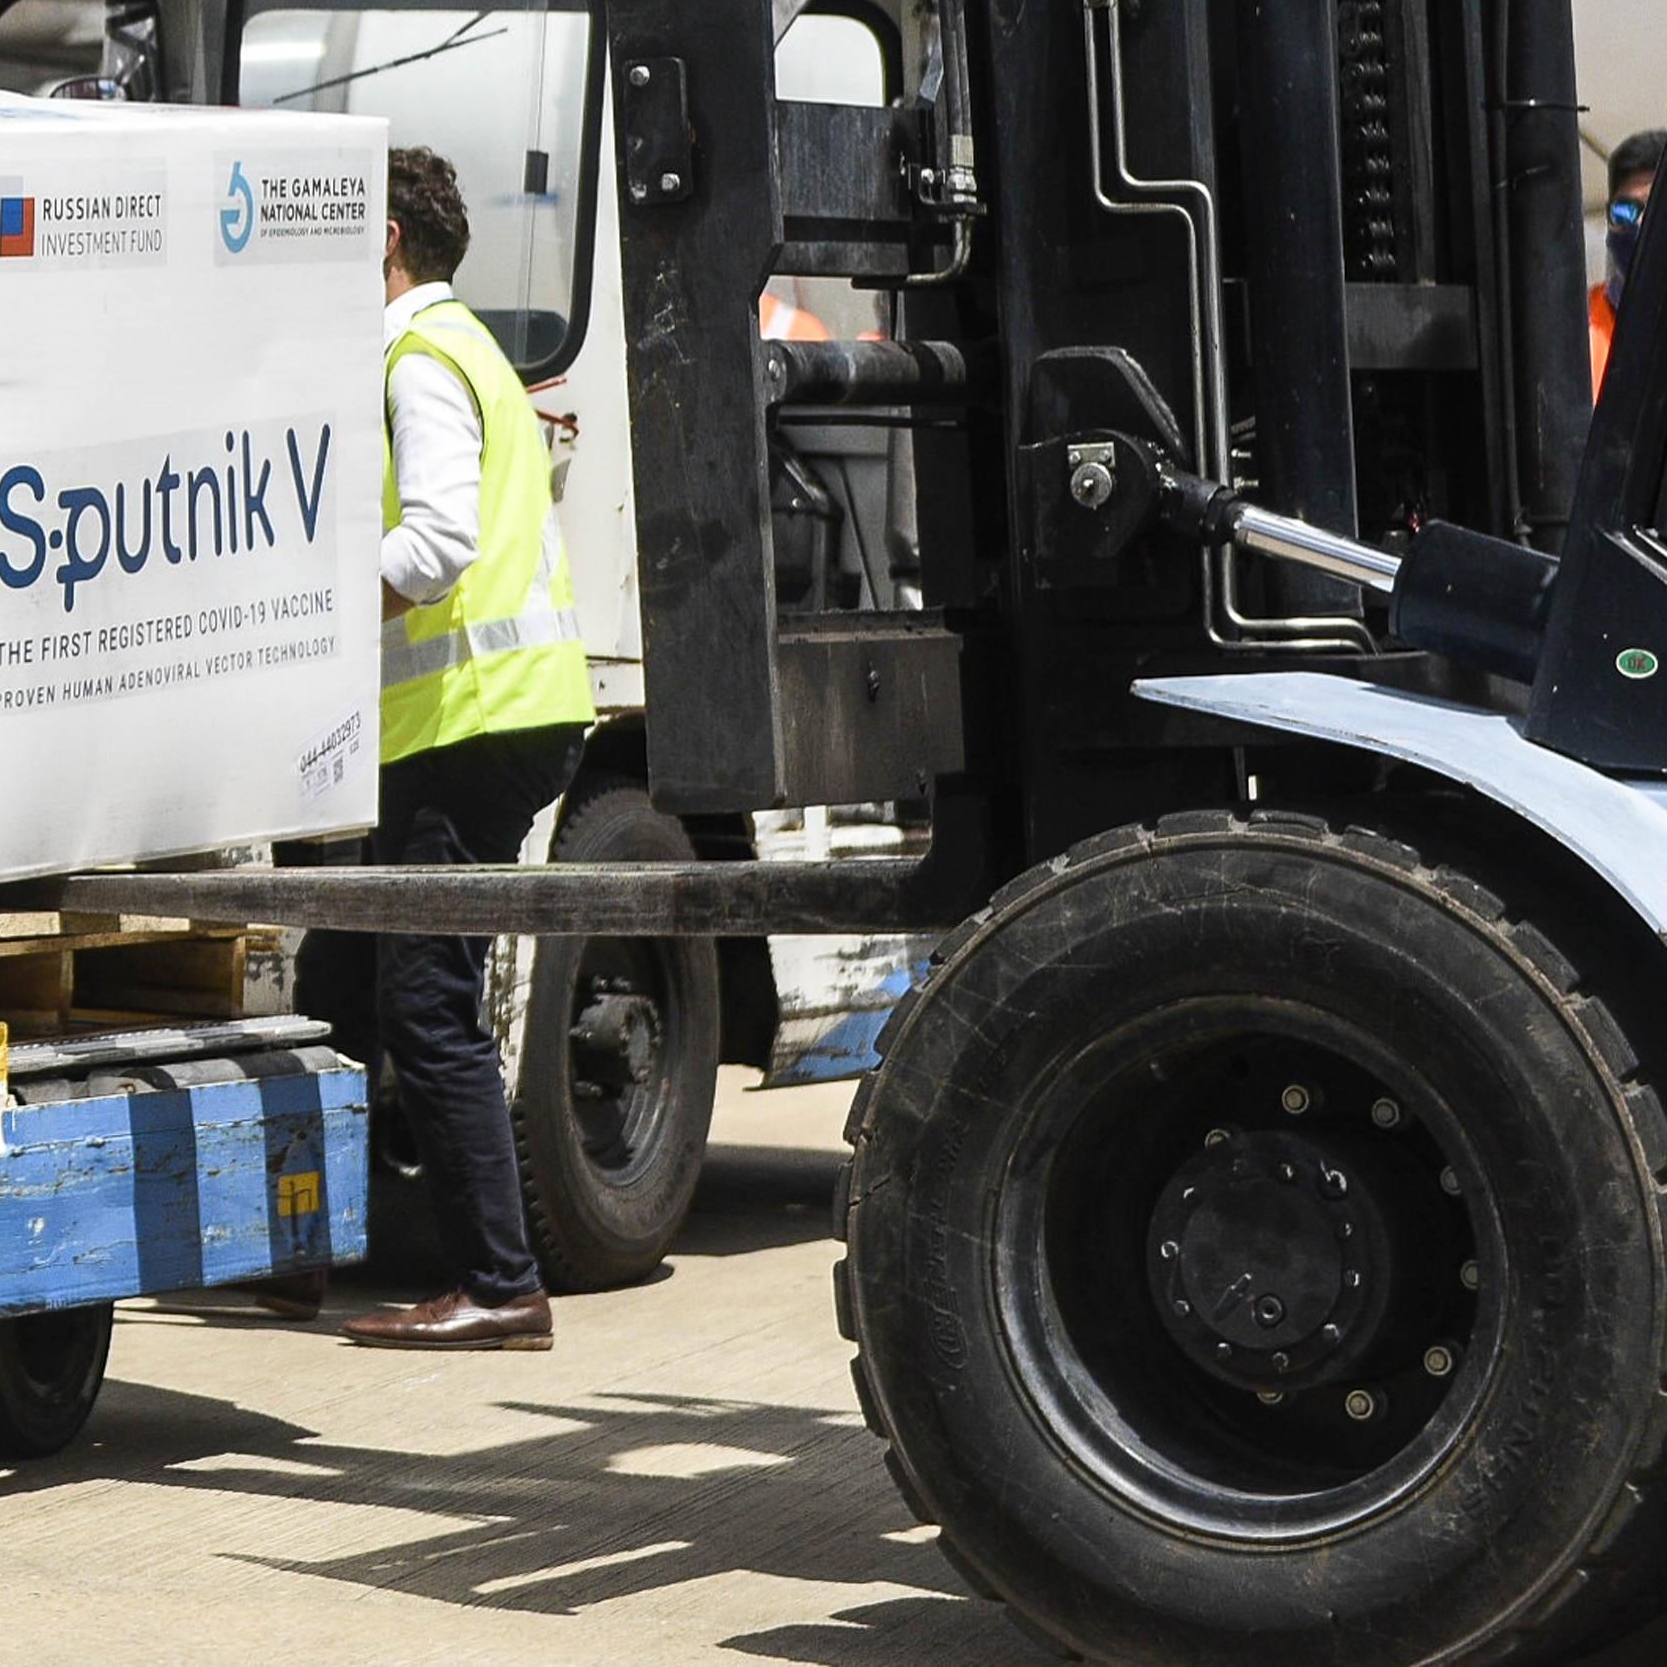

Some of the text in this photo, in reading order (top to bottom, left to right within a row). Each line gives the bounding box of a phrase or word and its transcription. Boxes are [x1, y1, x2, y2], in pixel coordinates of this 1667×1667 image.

[261, 177, 365, 198] THE GAMALEYA
[42, 195, 161, 221] RUSSIAN DIRECT
[260, 202, 365, 222] NATIONAL CENTER
[41, 227, 162, 257] INVESTMENT FUND
[286, 424, 331, 543] V
[41, 631, 91, 661] FIRST
[98, 614, 192, 652] REGISTERED
[198, 601, 265, 635] COVID-19
[271, 589, 332, 620] VACCINE
[62, 675, 112, 701] HUMAN
[118, 662, 200, 692] ADENOVIRAL
[205, 651, 252, 675] VECTOR
[257, 636, 335, 664] TECHNOLOGY
